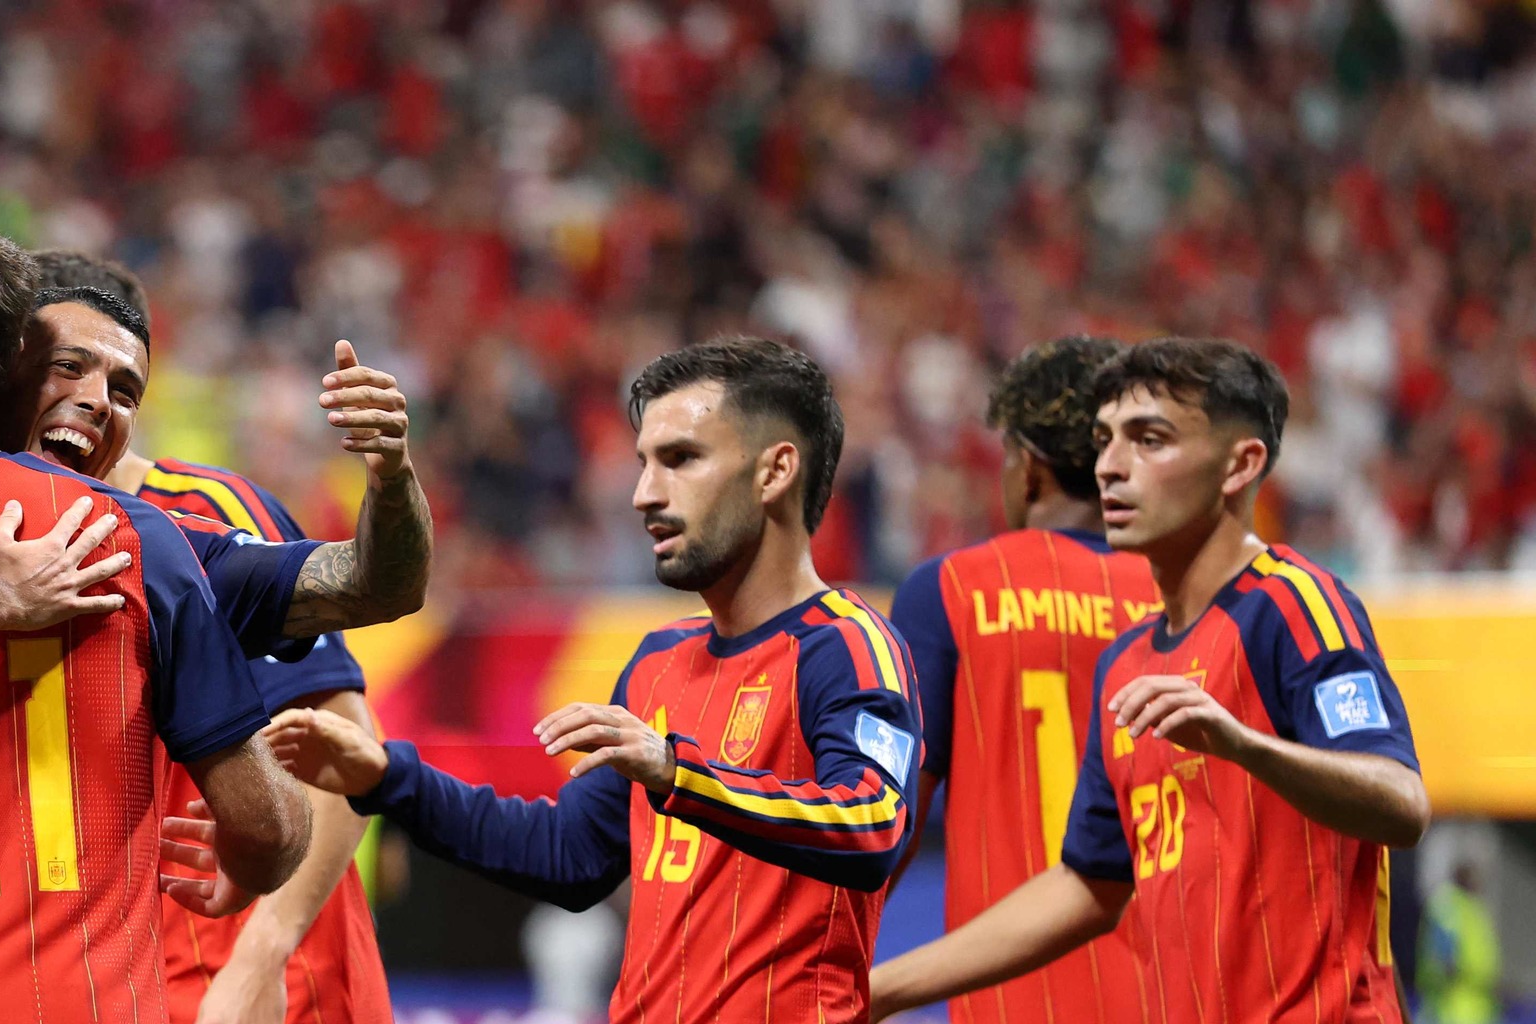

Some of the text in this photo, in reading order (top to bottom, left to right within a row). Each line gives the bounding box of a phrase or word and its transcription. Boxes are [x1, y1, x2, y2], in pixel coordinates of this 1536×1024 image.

[972, 588, 1116, 640] LAMINE
[1021, 670, 1078, 869] 1
[642, 813, 702, 883] 15
[1130, 774, 1187, 880] 20
